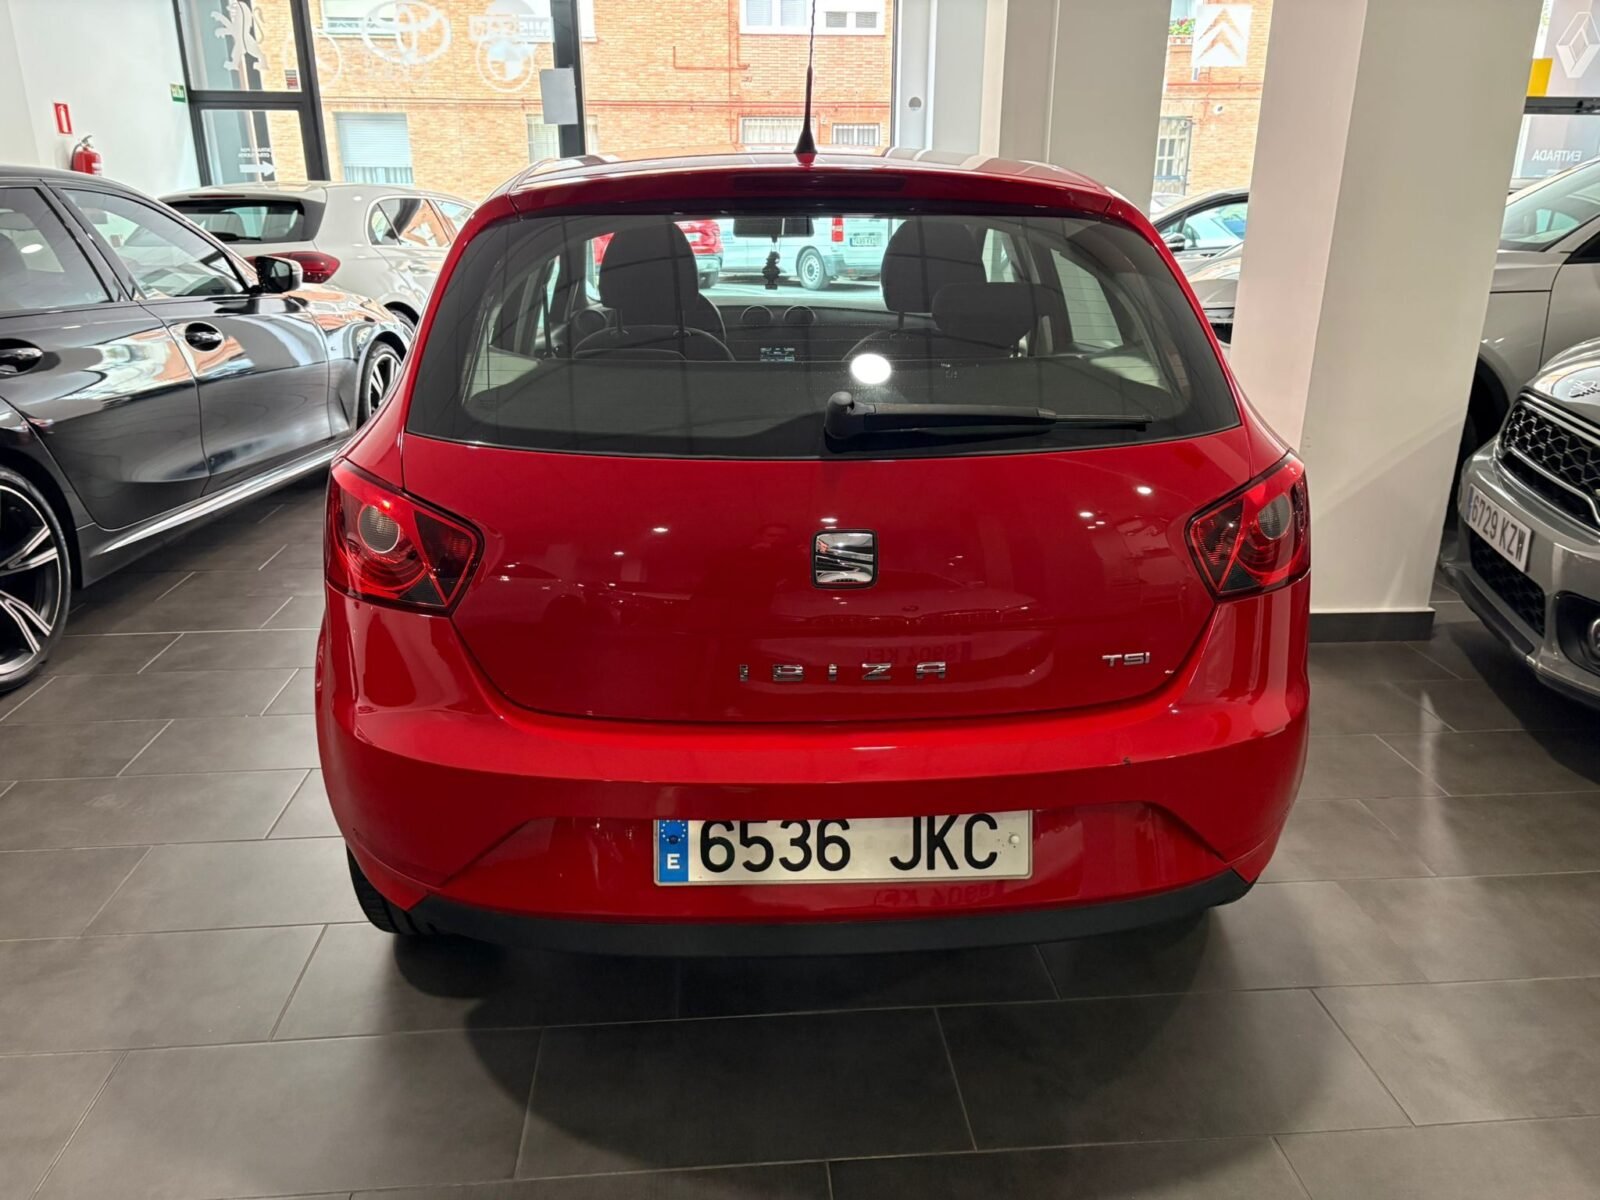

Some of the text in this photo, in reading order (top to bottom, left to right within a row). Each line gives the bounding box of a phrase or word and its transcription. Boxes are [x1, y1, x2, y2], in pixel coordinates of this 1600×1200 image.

[1471, 495, 1498, 540] 6729
[740, 661, 946, 683] IBIZA
[1102, 651, 1150, 668] TSI
[667, 813, 998, 873] E 6536 JKC
